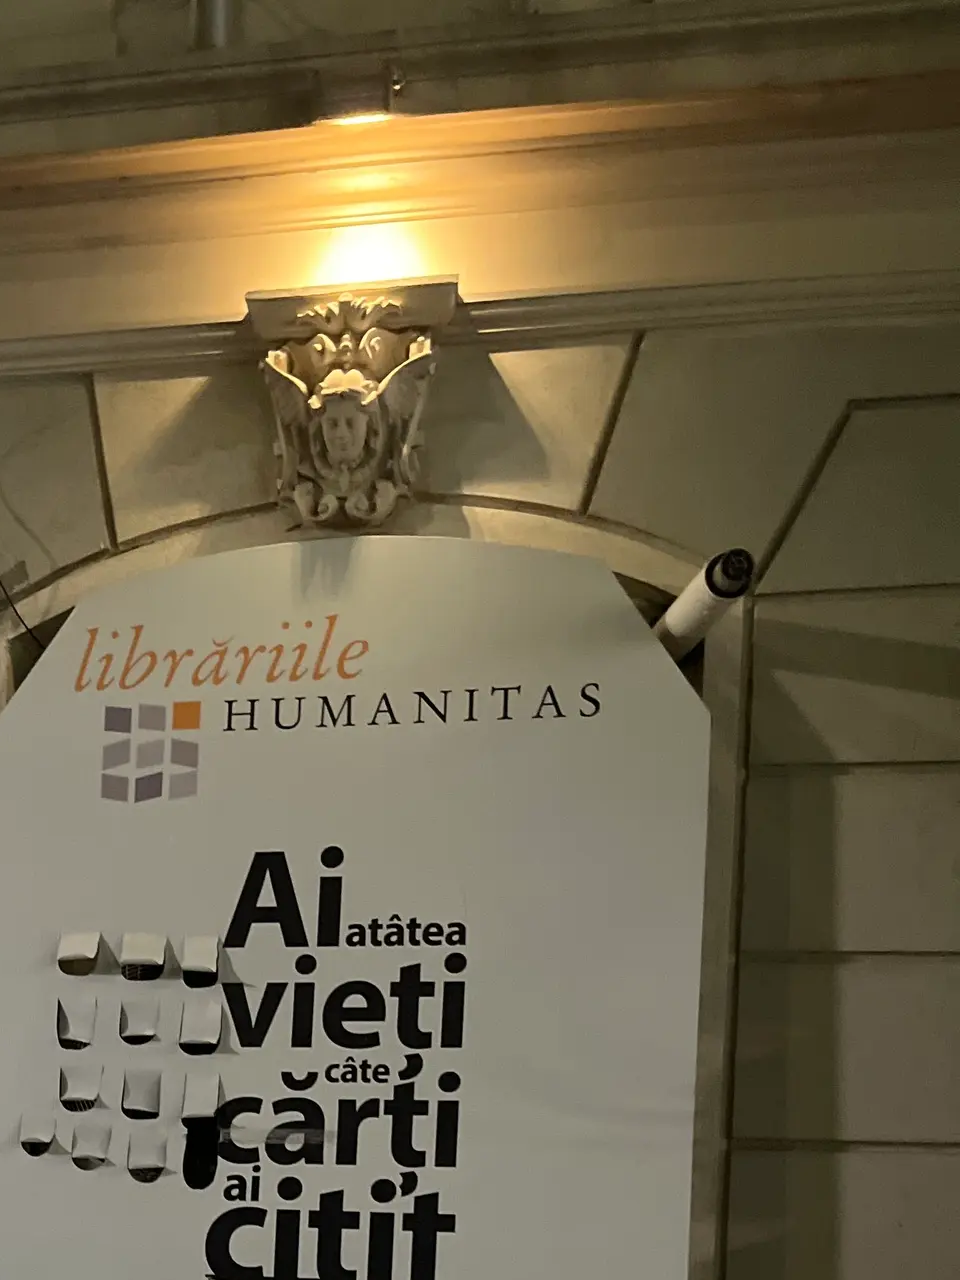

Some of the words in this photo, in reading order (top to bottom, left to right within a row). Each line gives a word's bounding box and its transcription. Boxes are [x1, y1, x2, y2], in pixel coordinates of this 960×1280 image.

[74, 614, 369, 692] librăriile
[223, 682, 602, 732] HUMANITAS
[223, 845, 344, 948] Ai
[345, 914, 466, 947] atâtea
[221, 952, 467, 1080] vieți
[324, 1056, 390, 1084] câte
[213, 1071, 461, 1197] cărți
[223, 1165, 261, 1201] ai
